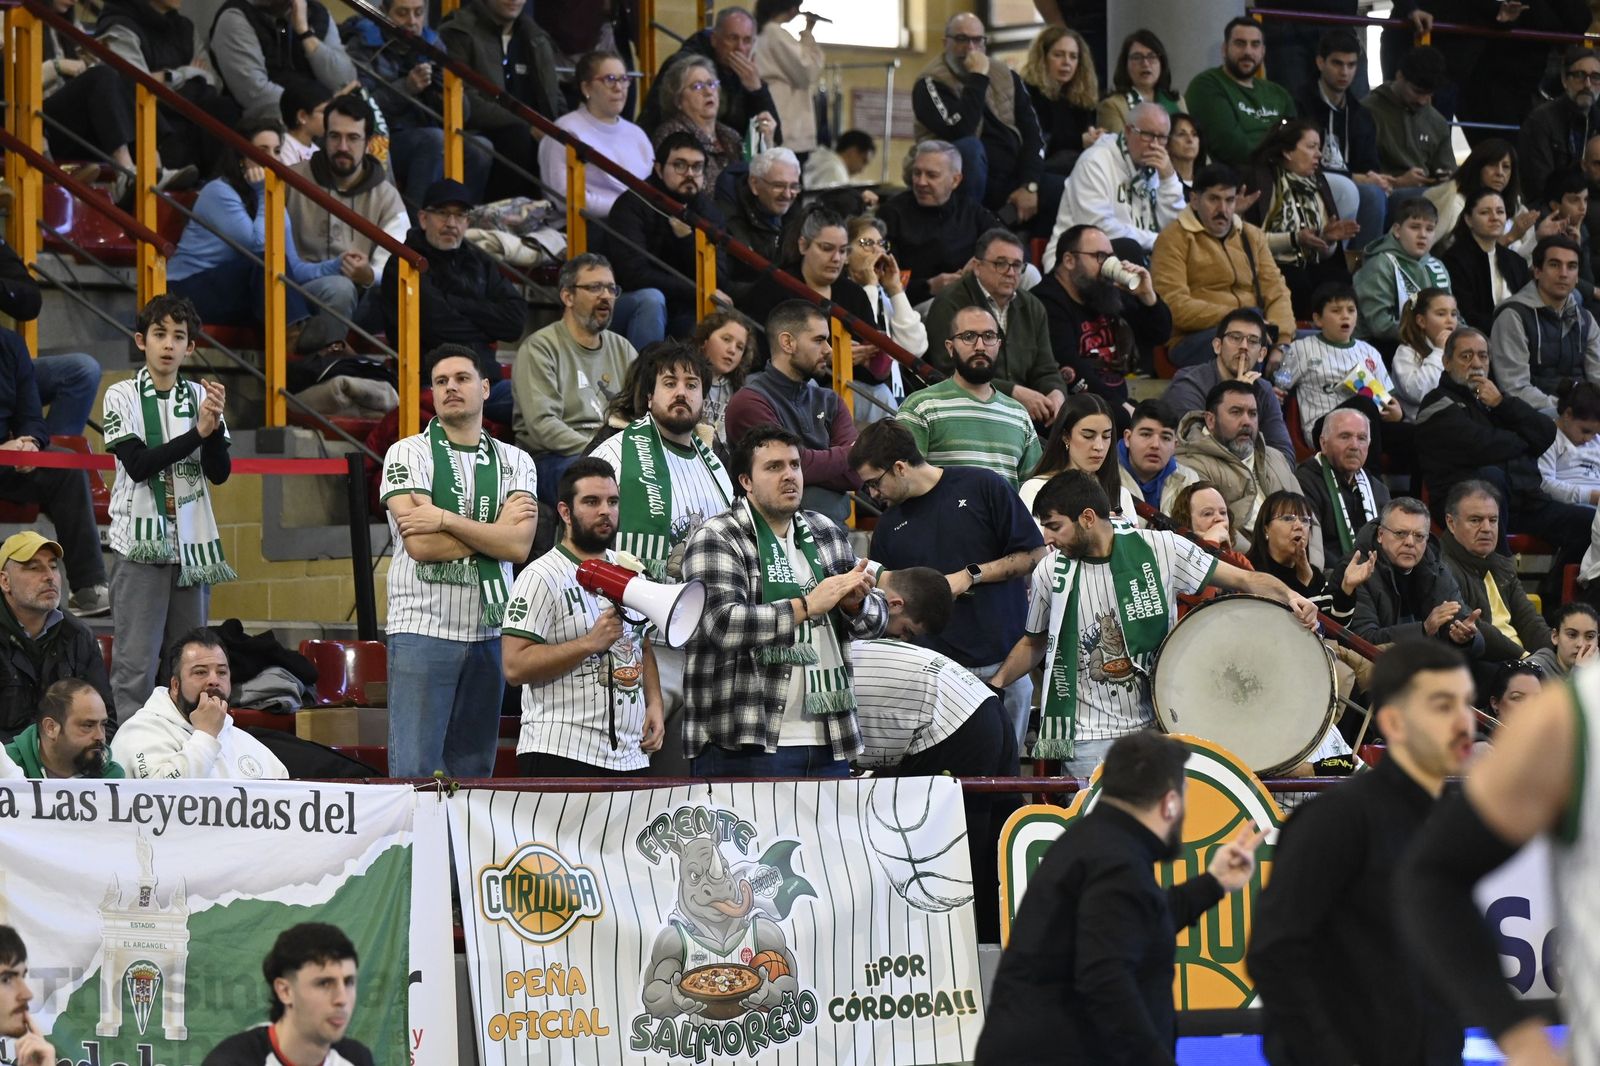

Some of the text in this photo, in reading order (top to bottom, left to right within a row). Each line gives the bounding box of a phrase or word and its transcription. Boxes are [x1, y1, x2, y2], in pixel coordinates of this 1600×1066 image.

[767, 564, 777, 583] POR
[782, 566, 792, 583] POR
[1141, 562, 1164, 616] BALONCESTO
[563, 587, 587, 616] 14
[1125, 603, 1136, 622] POR
[1129, 578, 1145, 619] CORDOBA
[1140, 588, 1154, 618] POR EL
[27, 780, 98, 822] Las
[104, 782, 291, 837] Leyendas
[299, 790, 358, 835] del
[636, 805, 758, 865] FRENTE
[133, 941, 167, 949] ARCANGEL
[505, 962, 587, 998] PEÑA
[864, 954, 926, 987] ¡¡POR
[828, 989, 977, 1023] CÓRDOBA!!
[488, 1007, 610, 1042] OFICIAL
[630, 989, 818, 1064] SALMOREJO
